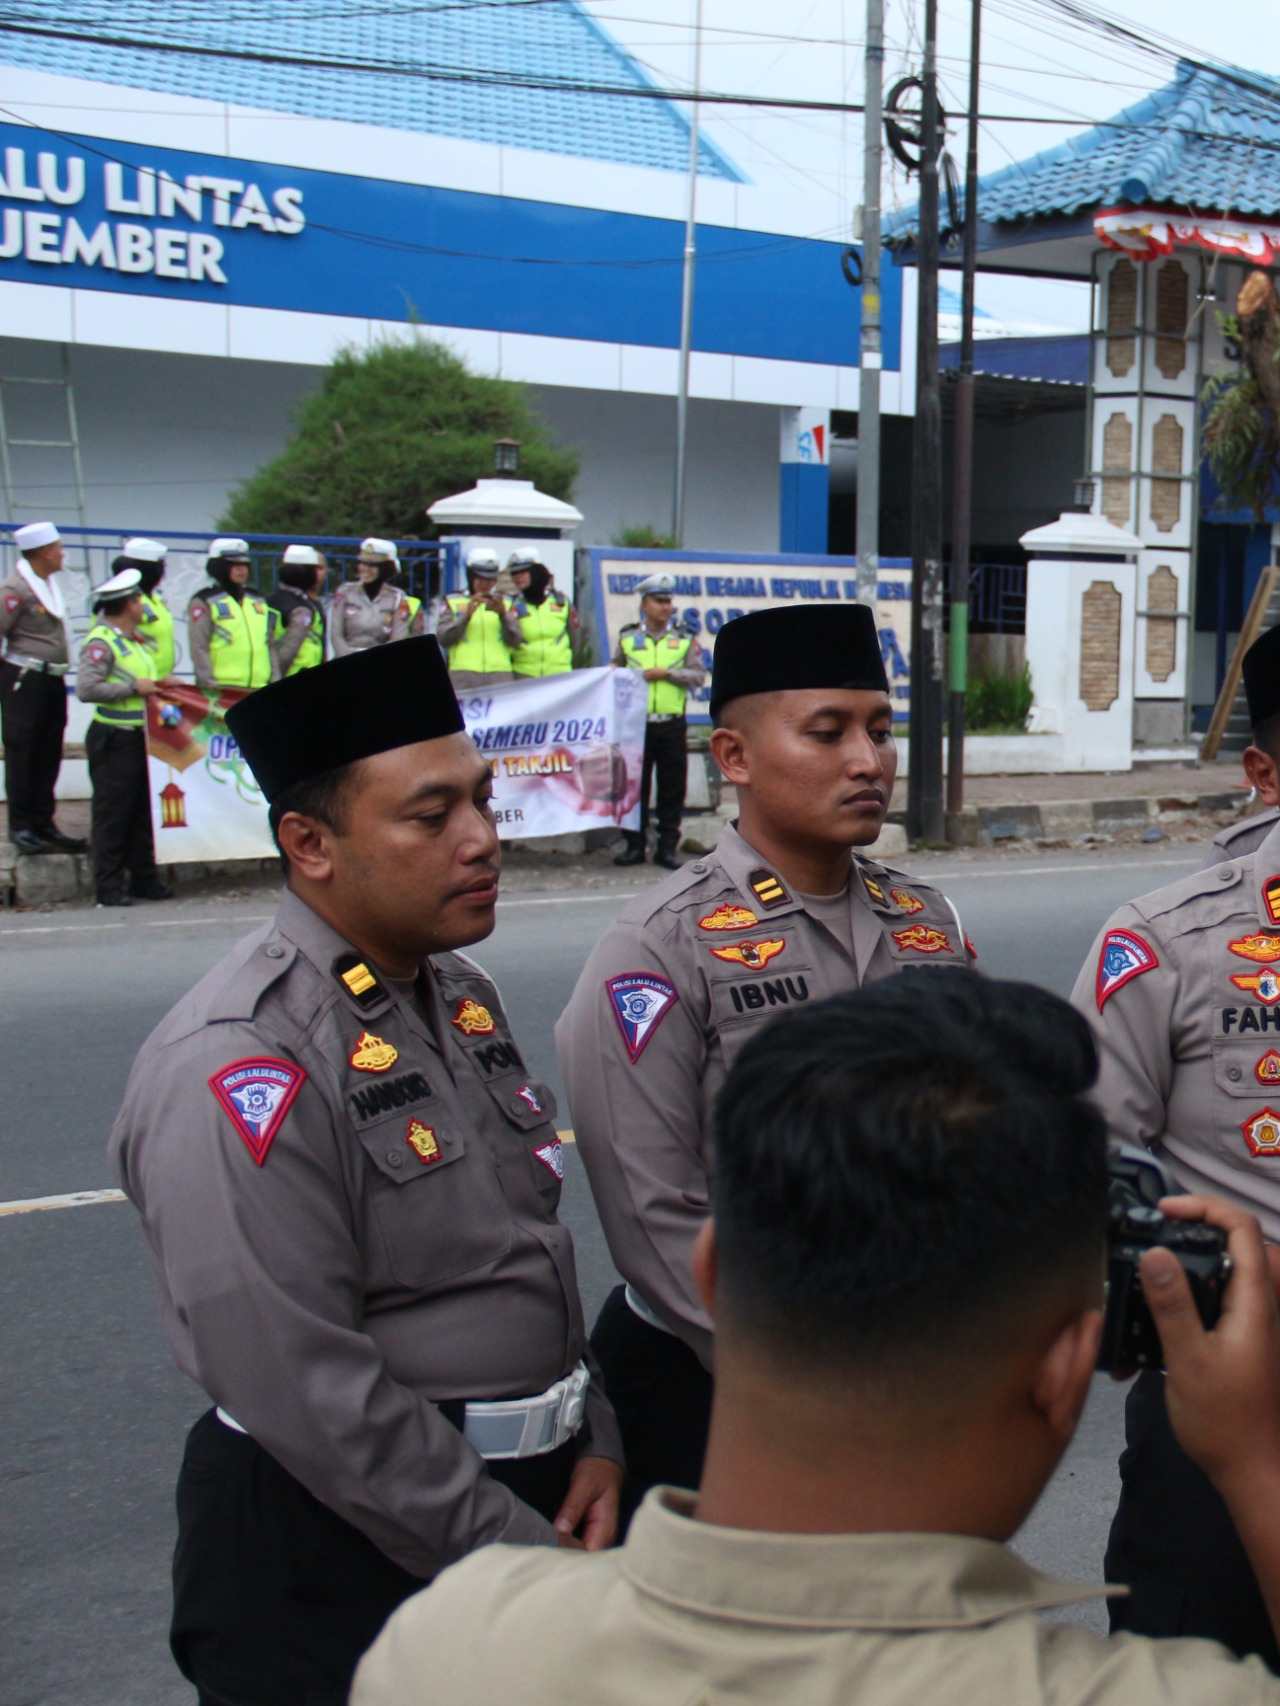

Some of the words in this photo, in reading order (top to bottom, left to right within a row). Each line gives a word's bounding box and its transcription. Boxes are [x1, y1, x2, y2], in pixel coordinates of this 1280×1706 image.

[104, 161, 306, 234] LINTAS
[0, 208, 228, 283] JEMBER
[473, 721, 548, 749] SEMERU
[552, 717, 606, 743] 2024
[503, 752, 573, 777] TAKJIL
[729, 976, 809, 1013] IBNU
